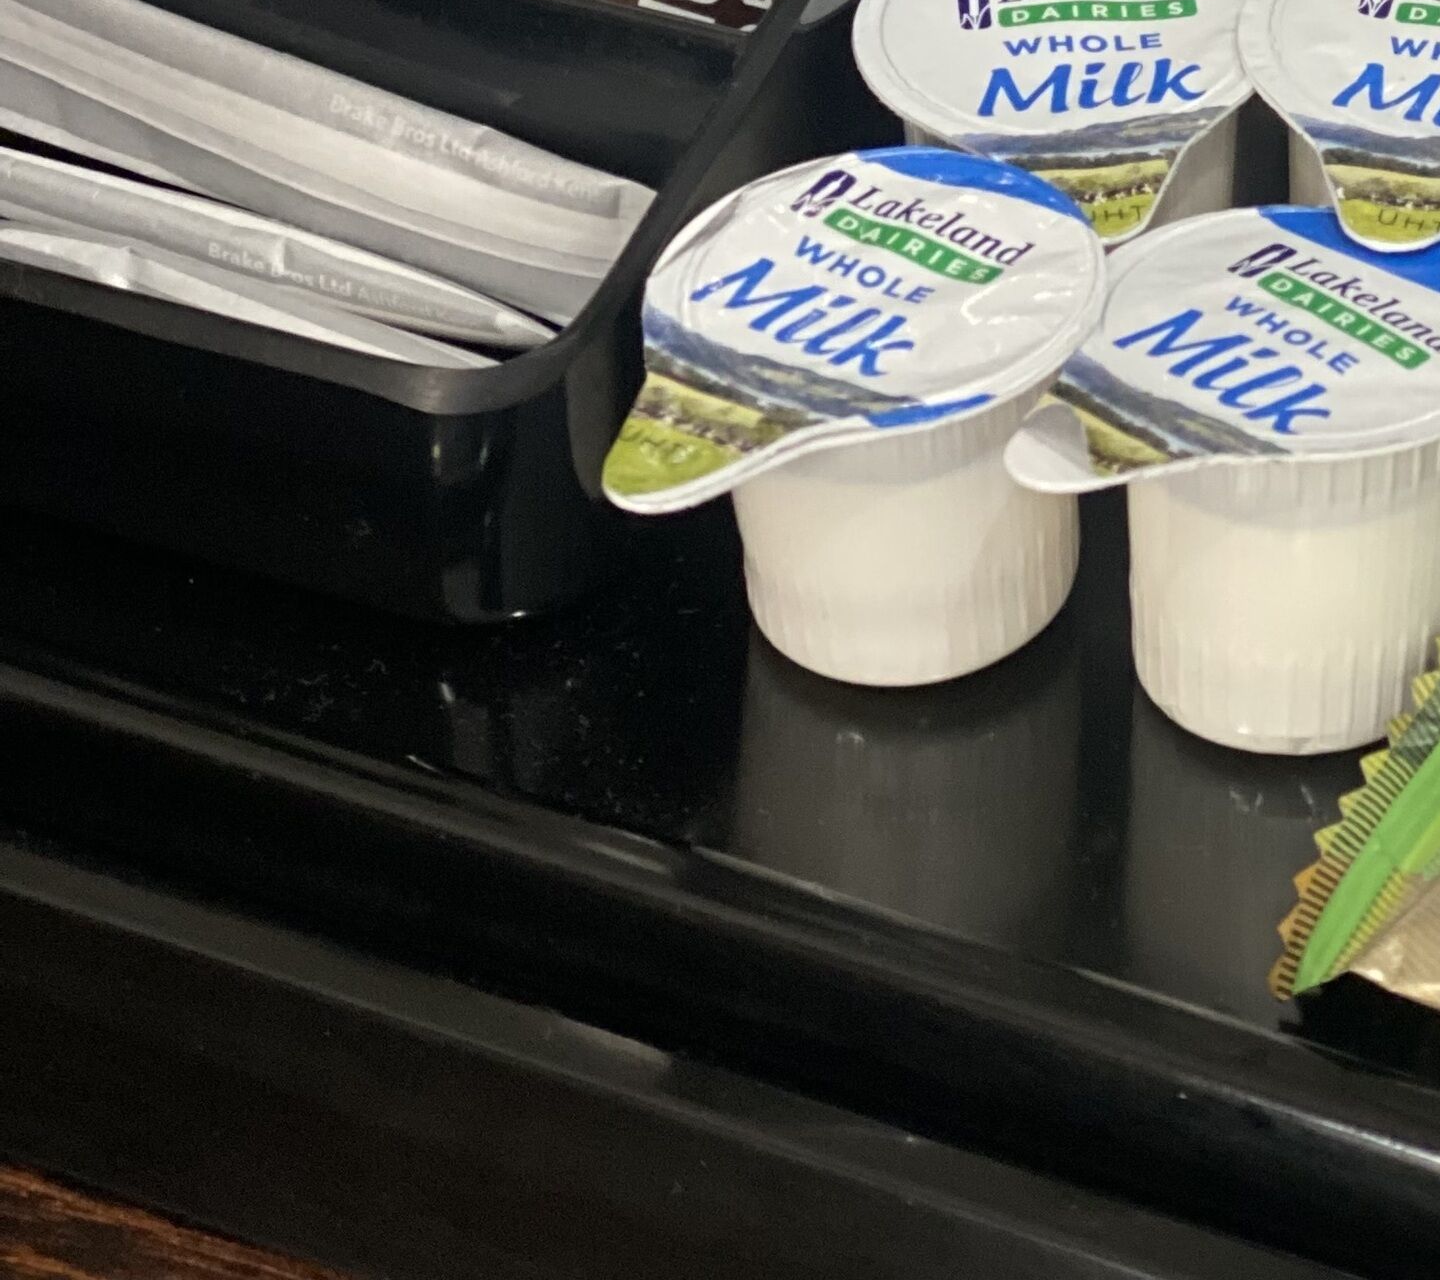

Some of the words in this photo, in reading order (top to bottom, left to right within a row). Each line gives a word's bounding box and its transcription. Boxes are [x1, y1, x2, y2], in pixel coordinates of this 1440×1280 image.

[1003, 33, 1163, 57] WHOLE
[1010, 1, 1185, 24] DAIRIES
[977, 58, 1208, 117] Milk
[837, 215, 992, 282] DAIRIES
[849, 185, 1036, 267] Lakeland
[794, 235, 935, 304] WHOLE
[690, 257, 916, 378] Milk
[1224, 295, 1360, 376] WHOLE
[1269, 278, 1413, 362] DAIRIES
[1112, 308, 1333, 436] Milk
